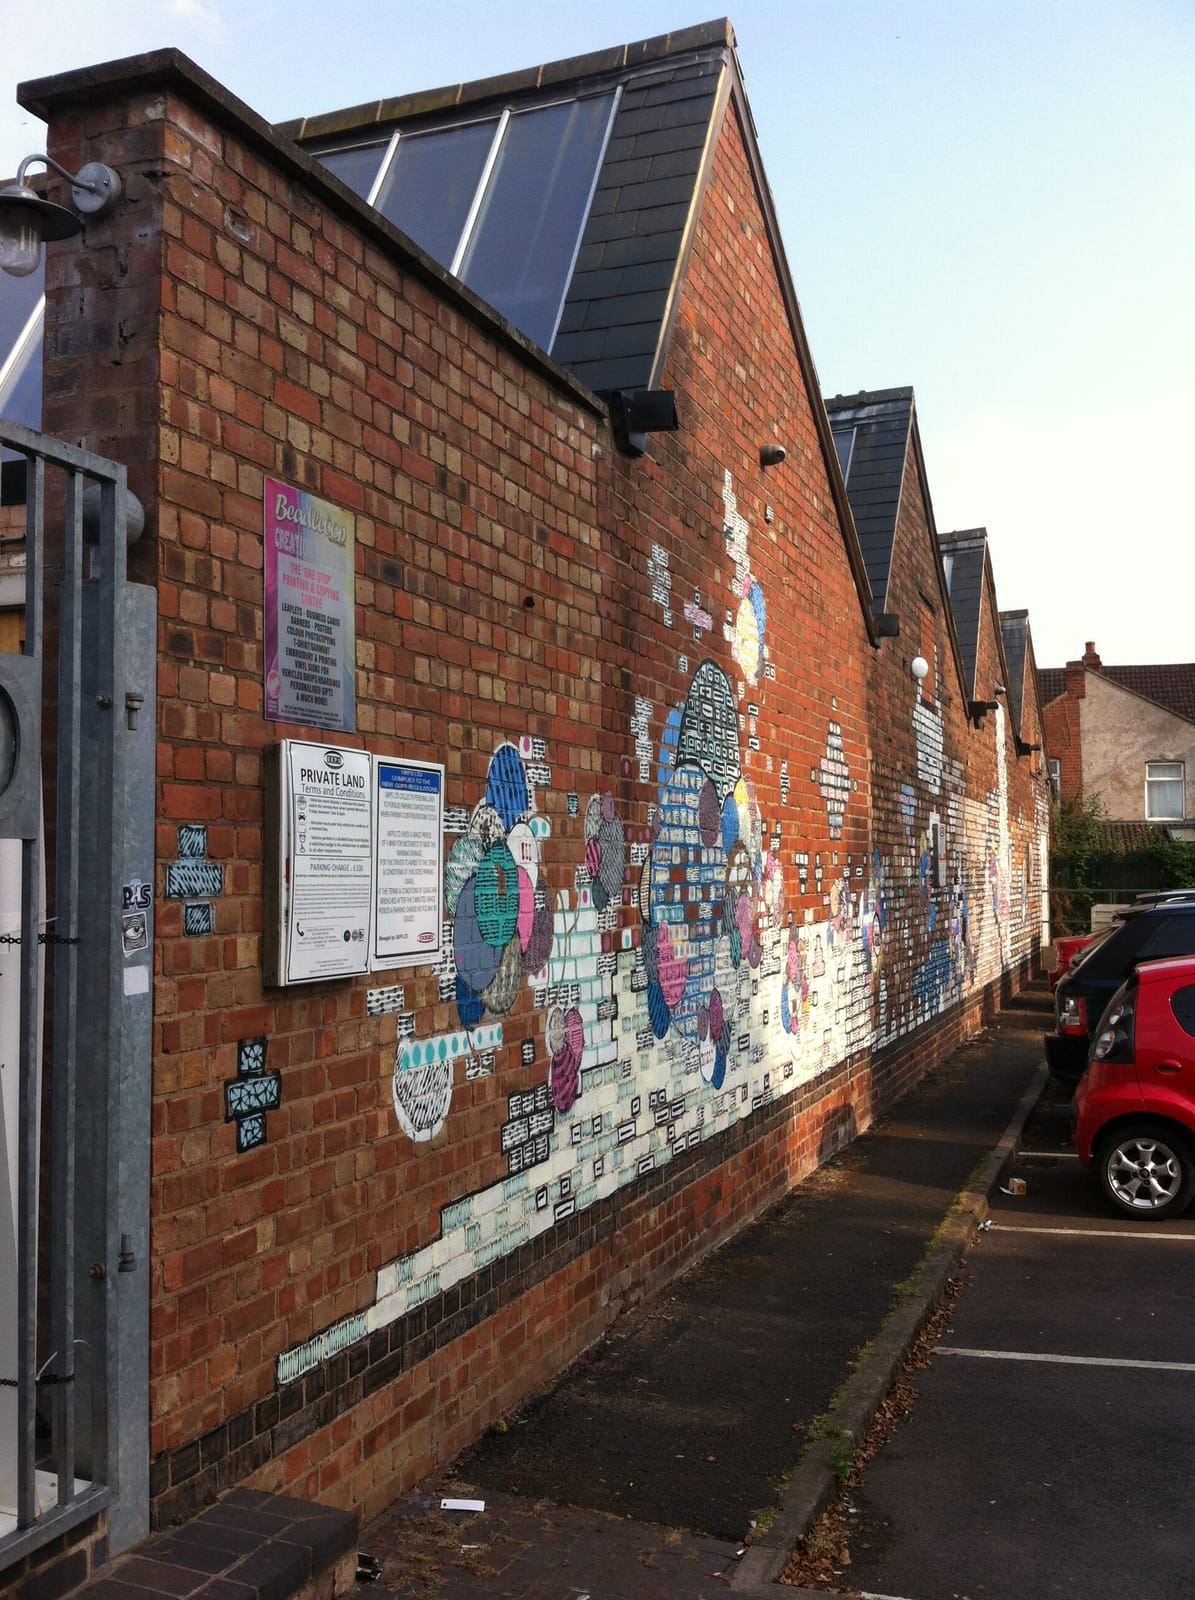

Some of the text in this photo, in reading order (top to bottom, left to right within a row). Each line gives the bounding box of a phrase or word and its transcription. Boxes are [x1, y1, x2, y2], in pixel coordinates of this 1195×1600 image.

[290, 562, 302, 576] THE
[282, 573, 340, 602] PRINTING & COPYING
[302, 592, 322, 609] CENTRE
[281, 602, 303, 616] LEAFLETS
[306, 609, 326, 623] BUSINESS
[327, 615, 341, 627] CARDS
[290, 615, 310, 629] BANNERS
[314, 621, 332, 635] POSTERS
[287, 625, 336, 647] COLOUR PHOTOCOPYING
[285, 647, 313, 660] EMBROIDERY
[318, 655, 337, 667] PRINTING
[294, 660, 307, 671] VINYL
[300, 768, 365, 789] PRIVATE LAND
[301, 783, 366, 799] Terms and Conditions
[310, 863, 331, 872] PARKING
